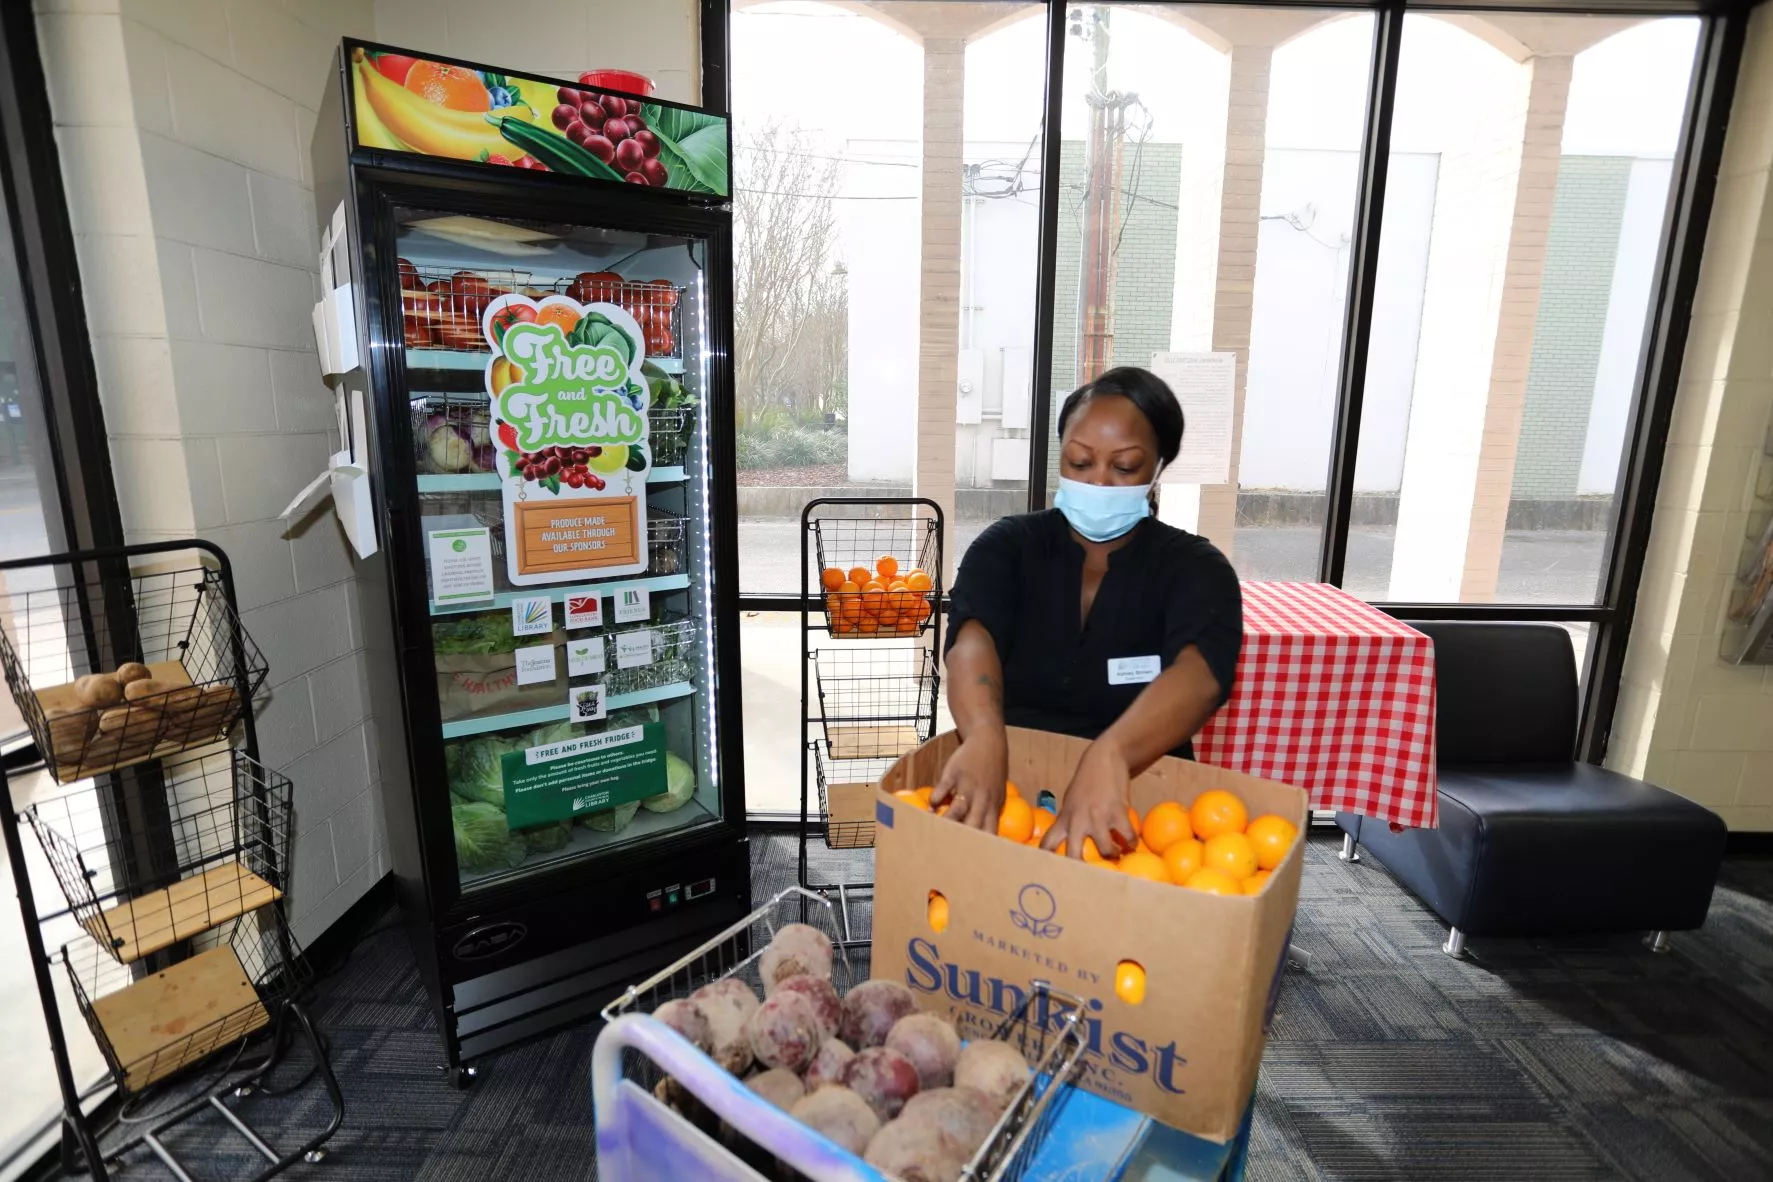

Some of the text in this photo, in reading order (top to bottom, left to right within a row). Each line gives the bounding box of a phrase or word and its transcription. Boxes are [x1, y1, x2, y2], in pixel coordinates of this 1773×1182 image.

[513, 332, 620, 384] Free
[558, 388, 587, 400] and
[508, 393, 637, 443] Fresh
[551, 516, 605, 528] PRODUCE MADE
[542, 528, 615, 541] AVAILABLE THROUGH
[553, 540, 606, 553] OUR SPONSORS
[517, 623, 548, 631] LIBRARY
[540, 732, 630, 758] FREE AND FRESH FRIDGE
[548, 769, 567, 777] amount
[559, 775, 581, 784] personal
[602, 764, 627, 773] donations
[585, 799, 610, 807] LIBRARY
[973, 929, 1101, 983] MARKETED BY
[906, 937, 1188, 1094] Sunkist
